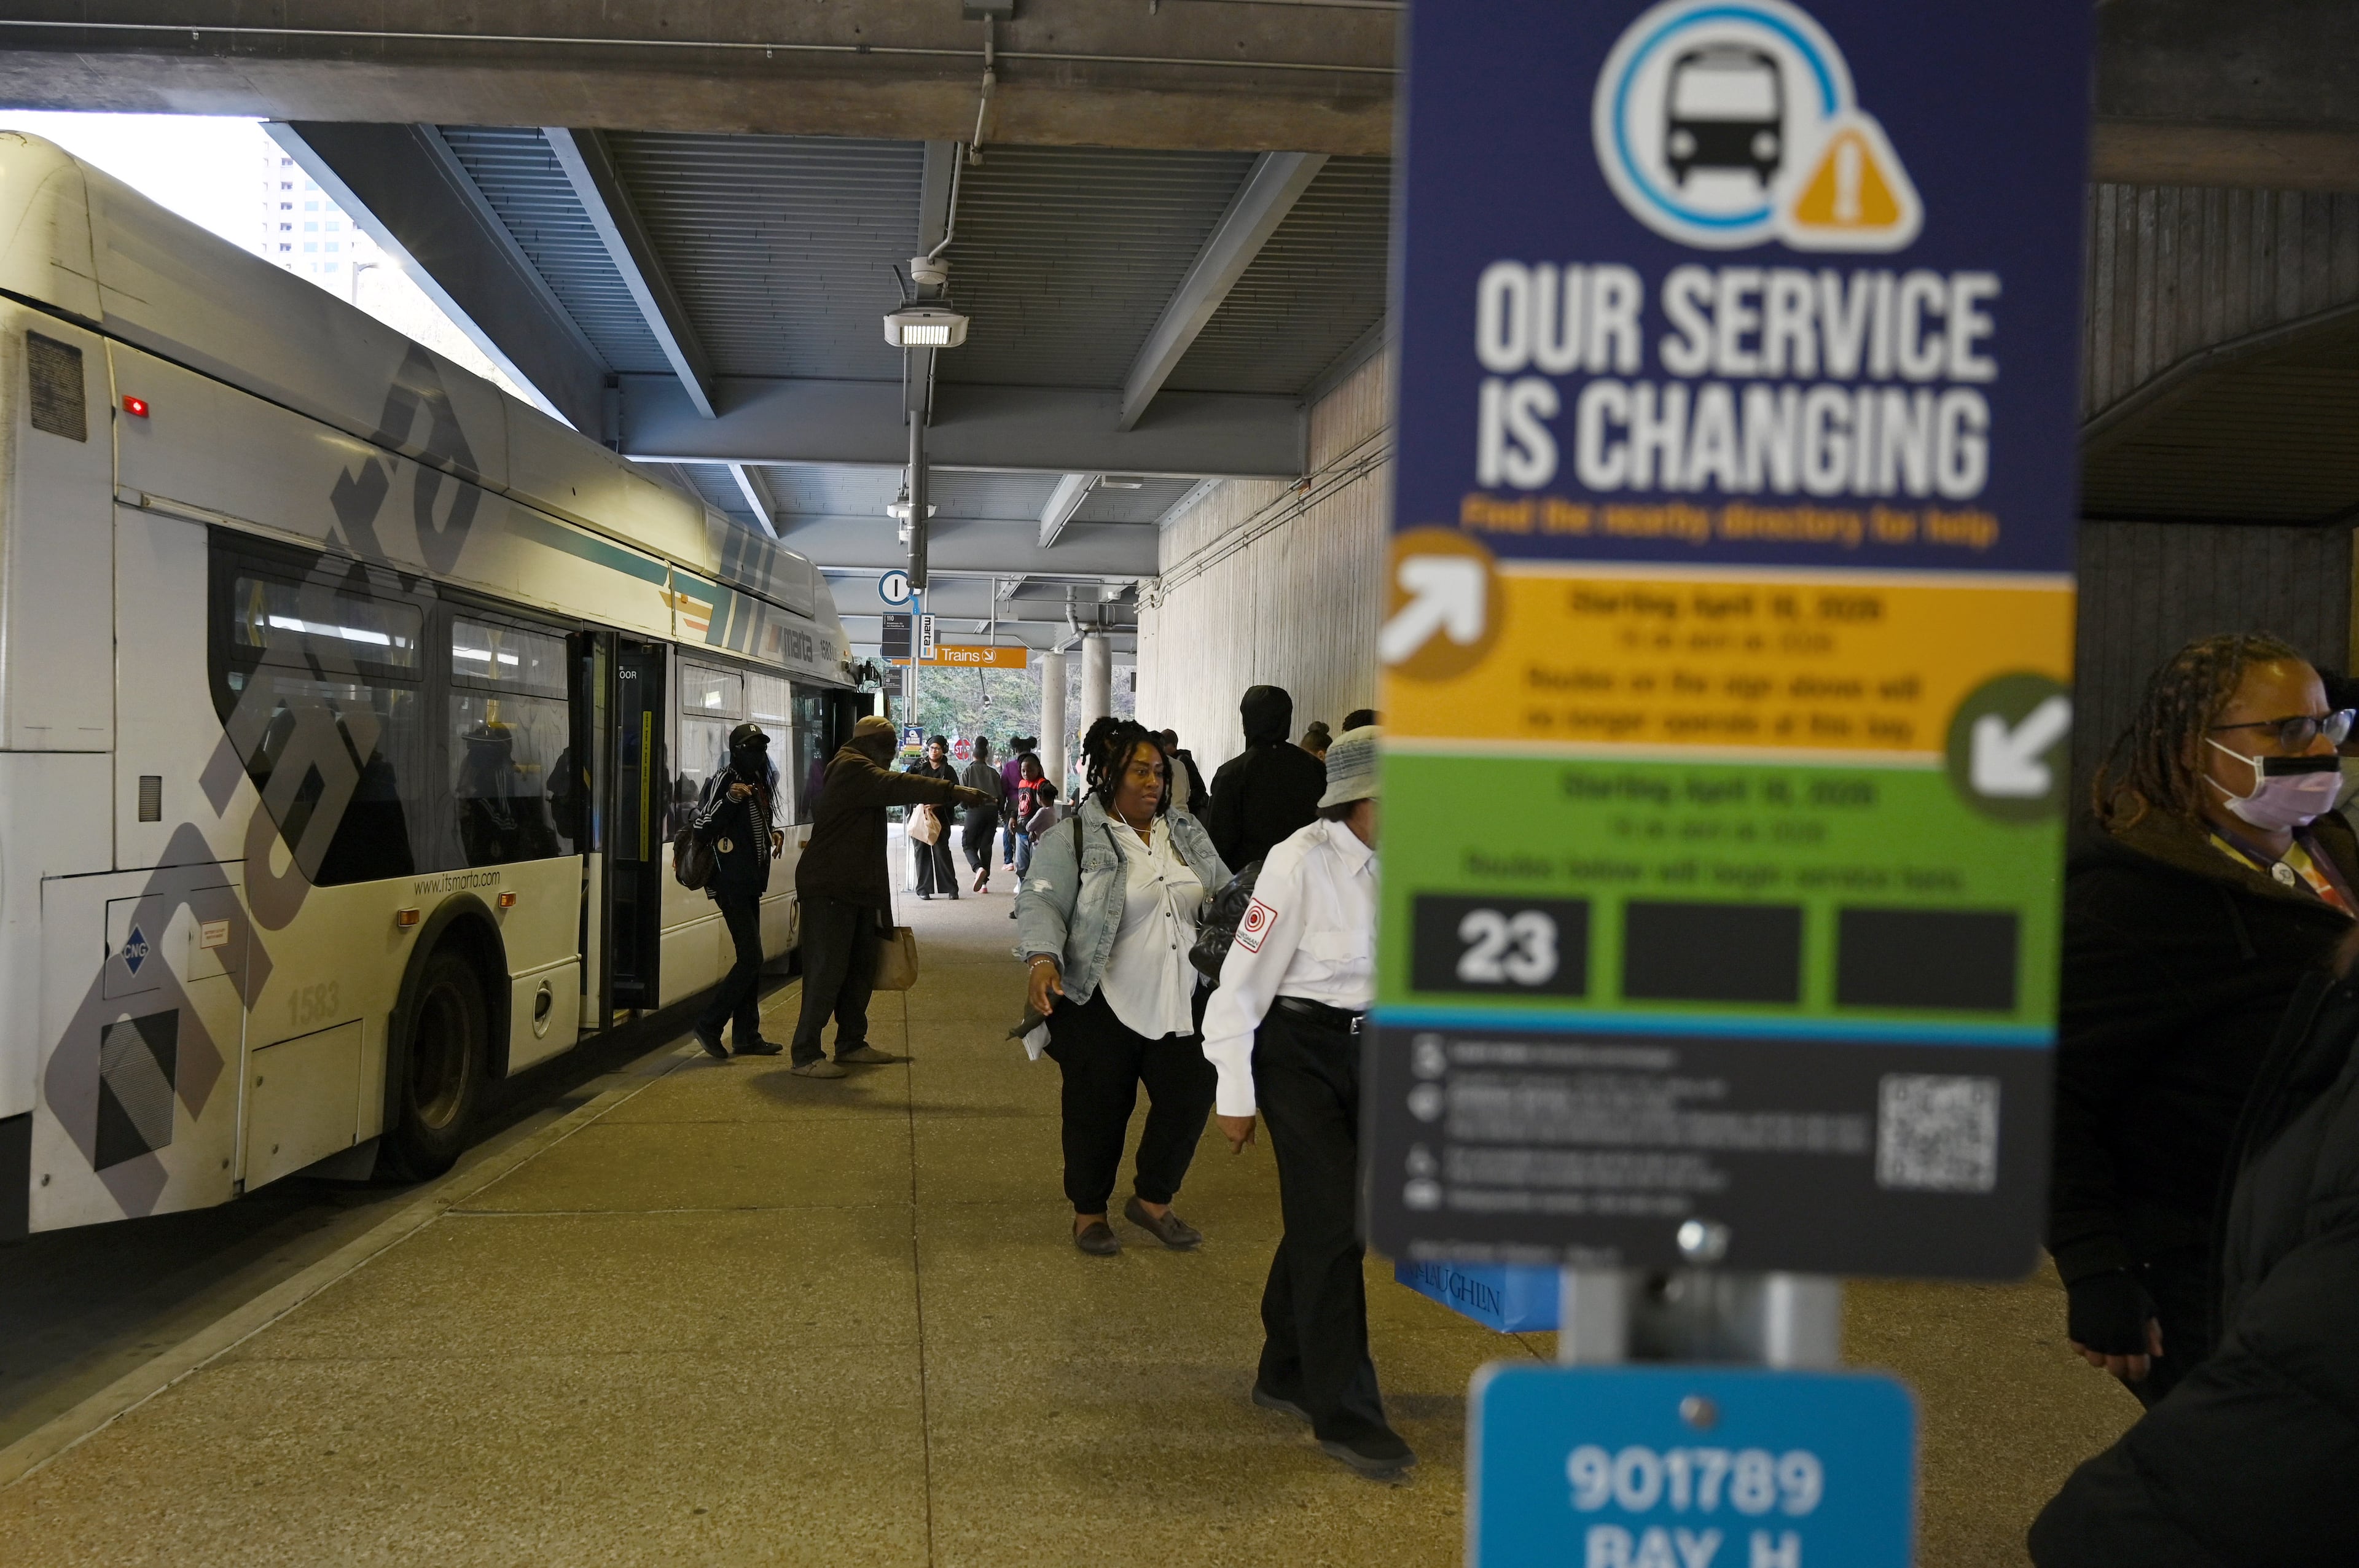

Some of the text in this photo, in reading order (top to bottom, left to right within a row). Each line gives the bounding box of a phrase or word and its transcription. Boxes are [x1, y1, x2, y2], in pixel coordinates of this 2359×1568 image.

[1478, 262, 2000, 382] OUR SERVICE
[1478, 377, 1989, 499] IS CHANGING
[783, 627, 832, 663] marta 1583
[942, 649, 979, 662] Trains
[955, 746, 971, 754] STP
[415, 871, 499, 895] www.itsmarta.com
[123, 942, 146, 958] CNG
[1456, 909, 1559, 985] 23
[288, 981, 339, 1026] 1583
[1566, 1444, 1823, 1516] 901789
[1585, 1524, 1802, 1568] BAY H
